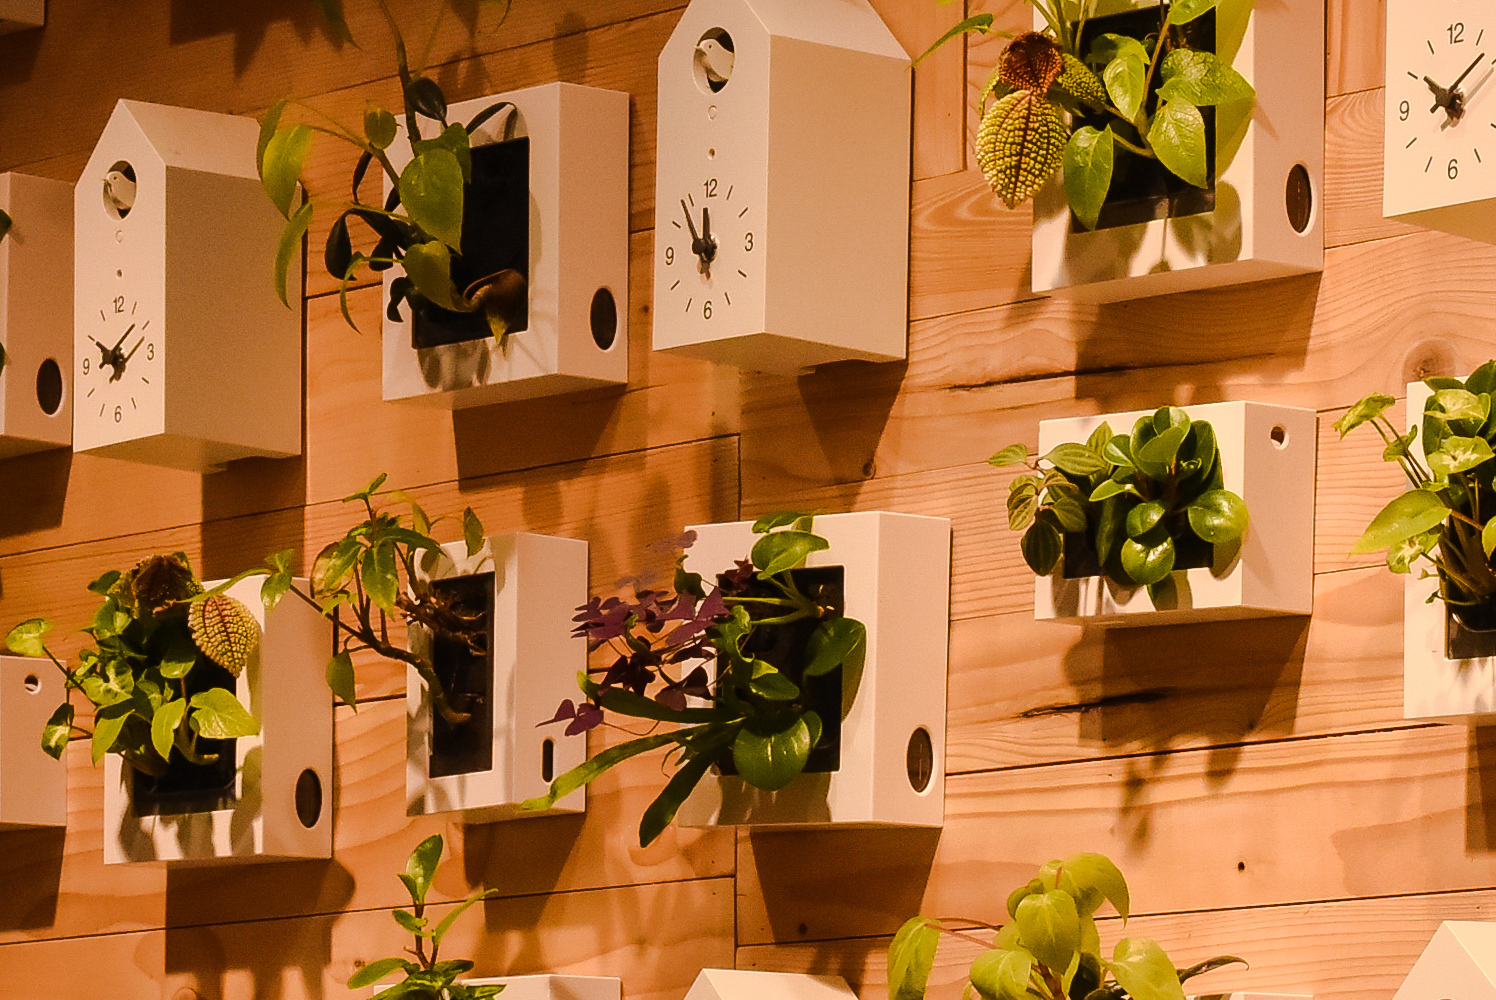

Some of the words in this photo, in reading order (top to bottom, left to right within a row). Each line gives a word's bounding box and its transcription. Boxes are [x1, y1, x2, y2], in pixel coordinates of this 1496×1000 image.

[1447, 23, 1464, 44] 12
[1400, 101, 1409, 121] 9
[1448, 159, 1458, 179] 6
[704, 179, 717, 198] 12
[745, 233, 753, 251] 3
[666, 247, 674, 265] 9
[113, 296, 124, 313] 12
[704, 301, 712, 319] 6
[147, 343, 154, 361] 3
[83, 358, 90, 375] 9
[115, 406, 121, 423] 6
